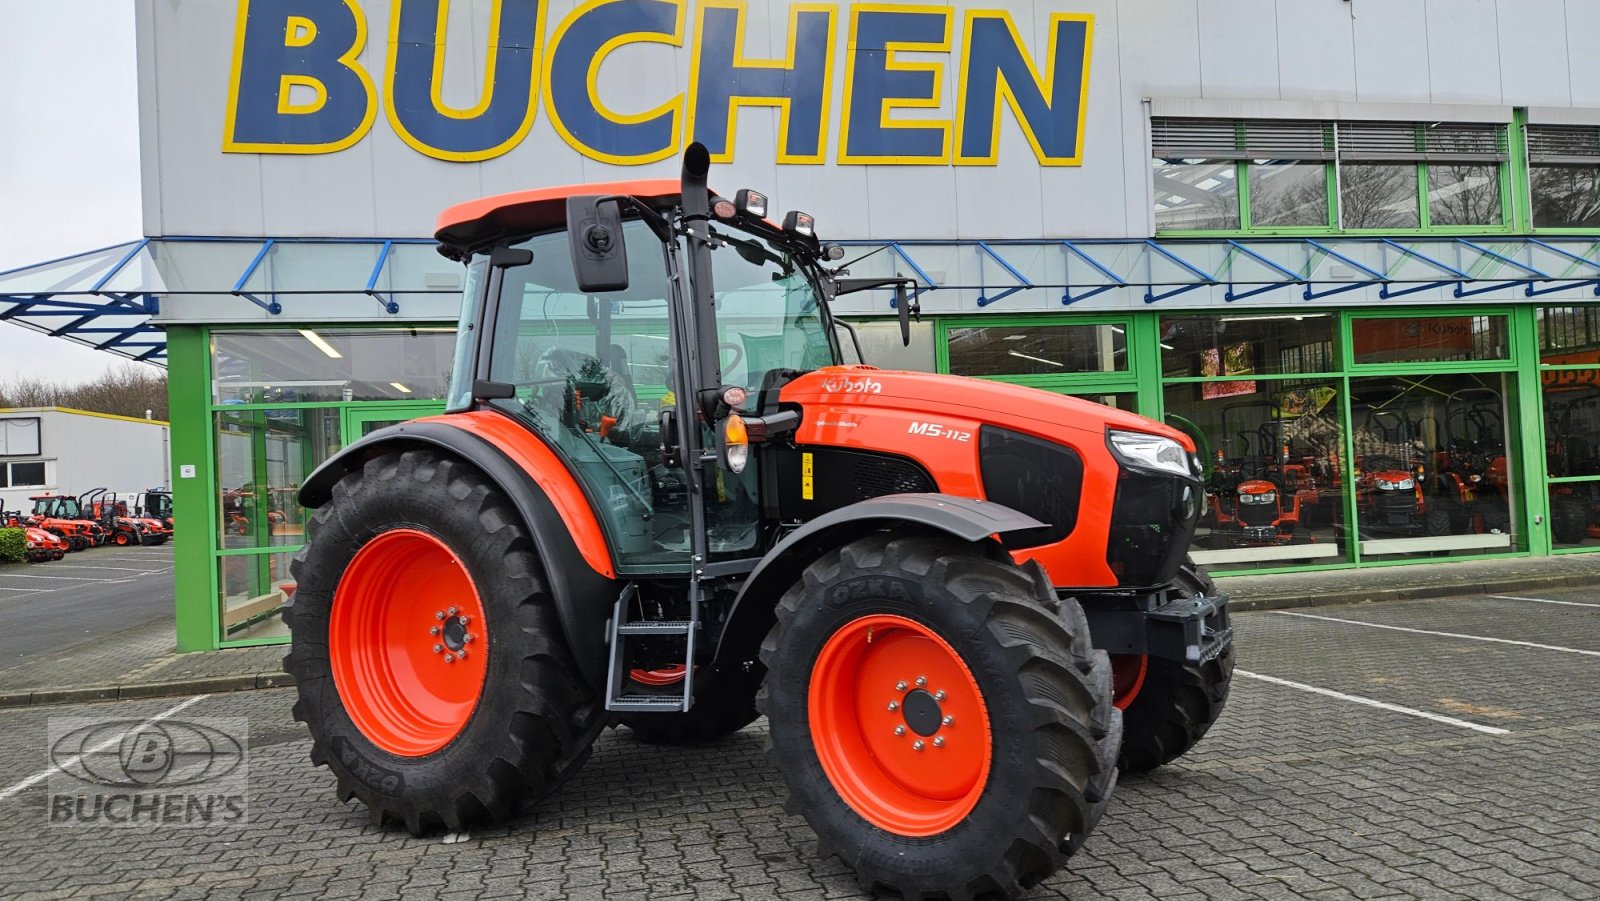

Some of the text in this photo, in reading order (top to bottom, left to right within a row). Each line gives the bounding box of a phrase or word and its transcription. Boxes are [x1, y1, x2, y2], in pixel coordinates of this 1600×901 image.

[222, 0, 1094, 166] BUCHEN
[820, 377, 882, 395] Kubota
[908, 421, 970, 442] M5-112
